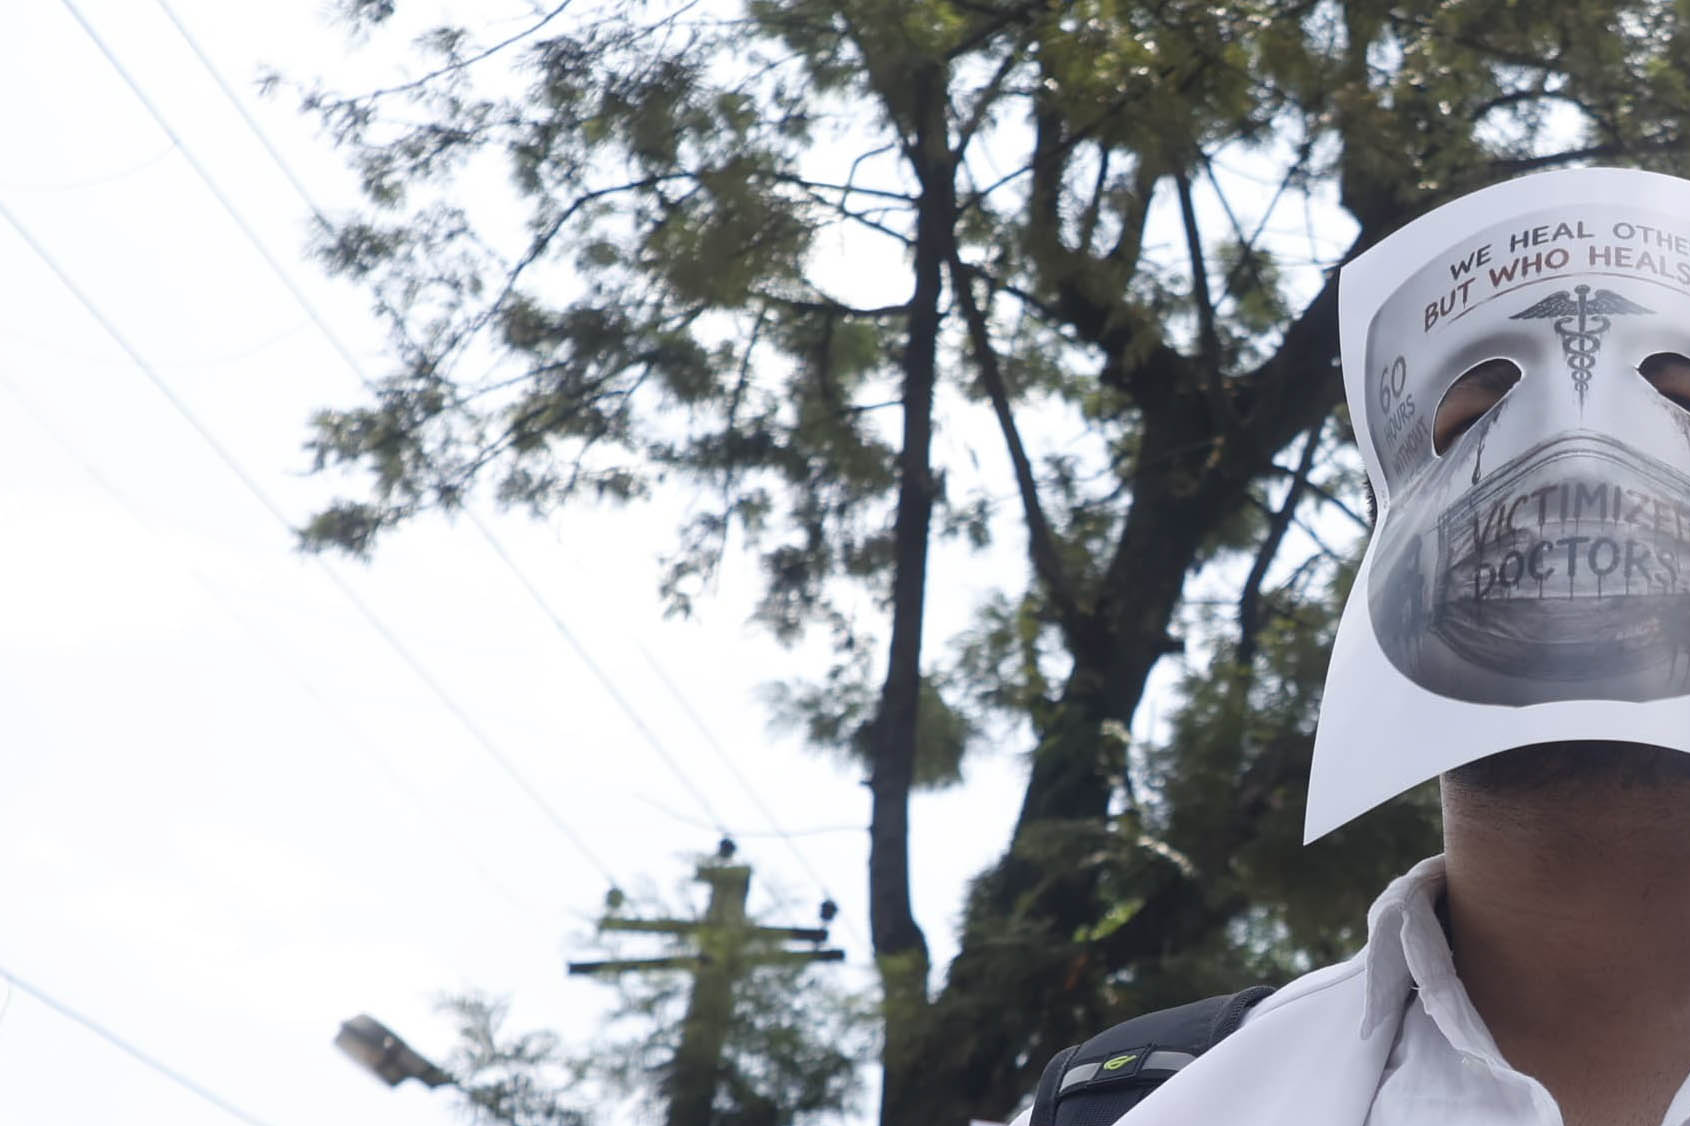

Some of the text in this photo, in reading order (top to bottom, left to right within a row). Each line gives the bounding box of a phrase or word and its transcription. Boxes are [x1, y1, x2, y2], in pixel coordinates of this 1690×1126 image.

[1450, 244, 1493, 281] WE
[1510, 221, 1595, 253] HEAL
[1424, 277, 1476, 333] BUT
[1489, 247, 1570, 288] WHO
[1380, 355, 1407, 415] 60
[1474, 536, 1679, 598] DOCTORS
